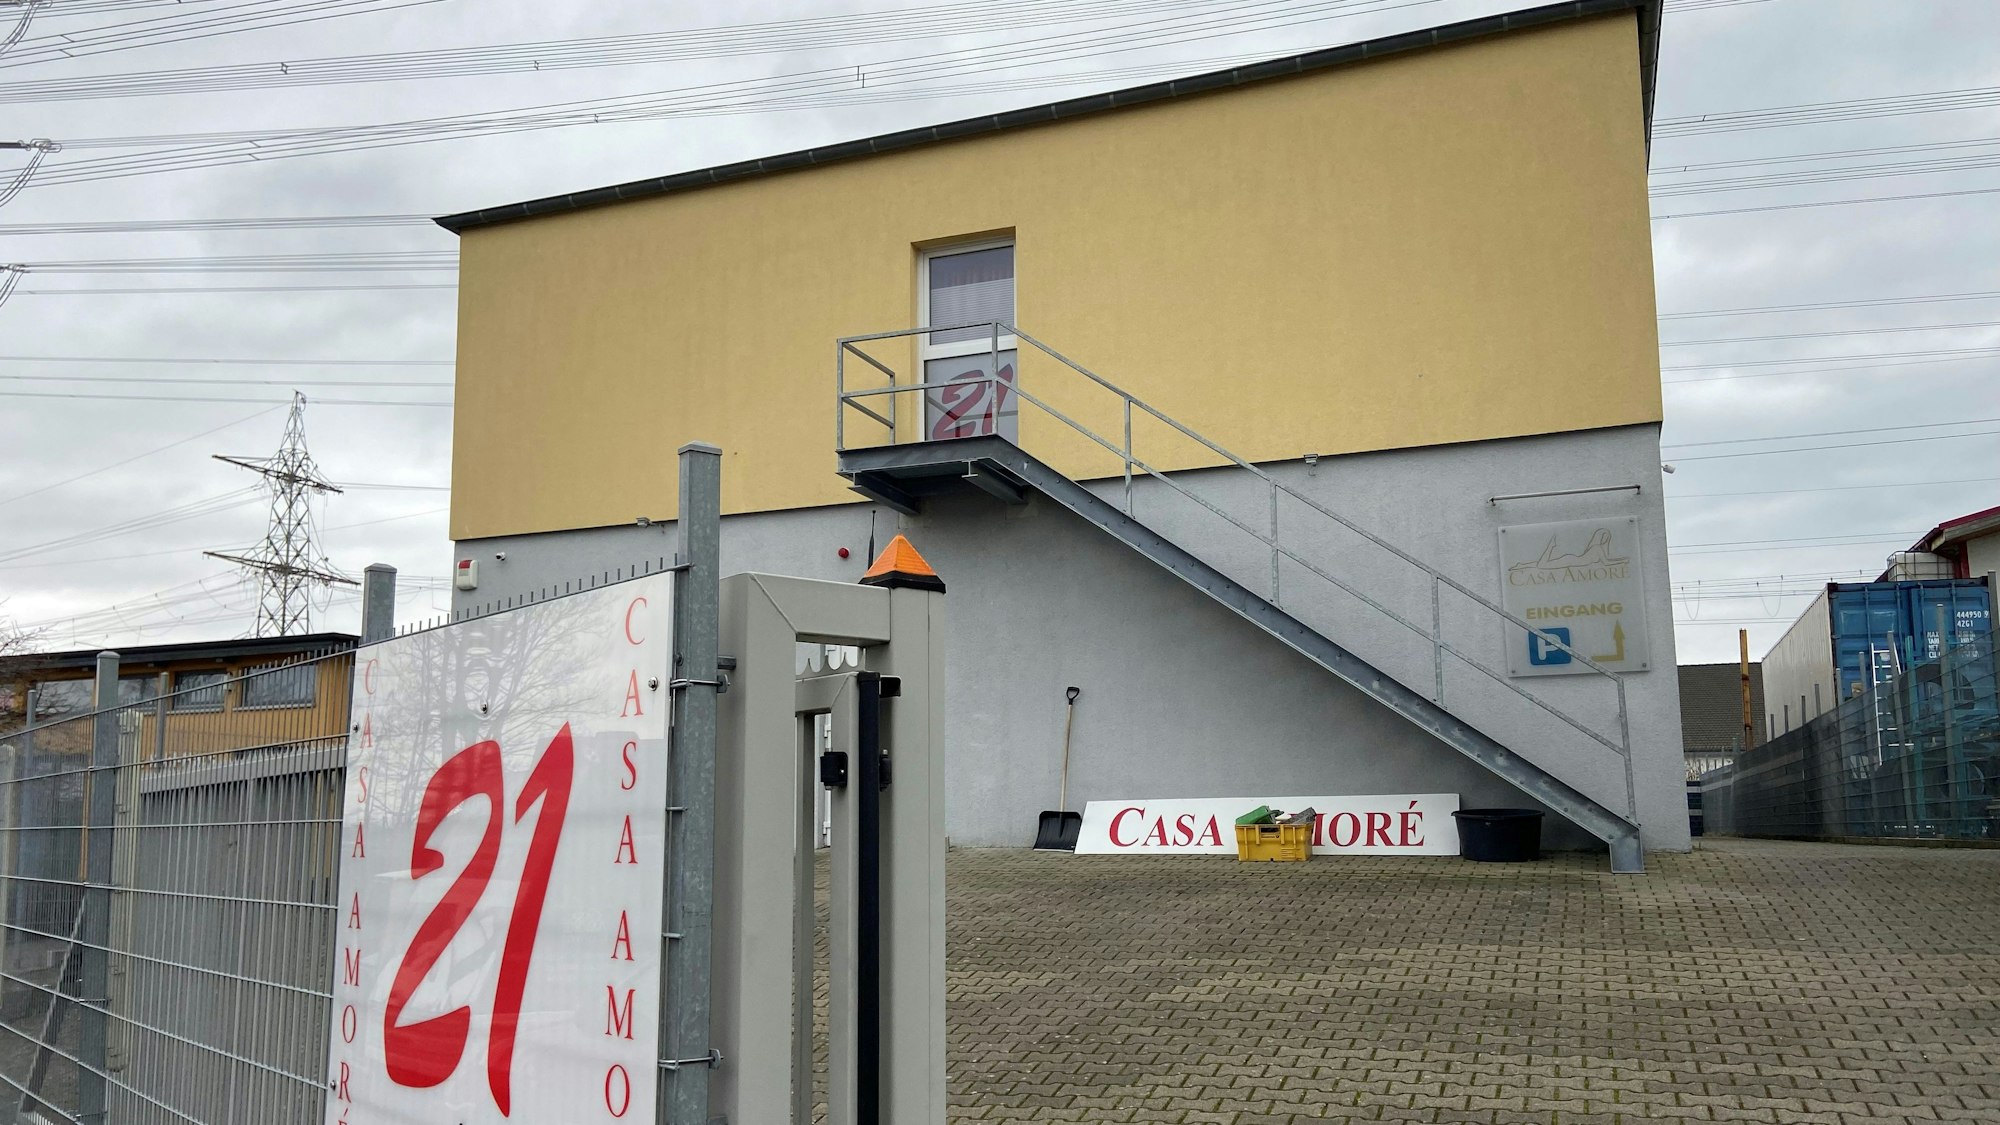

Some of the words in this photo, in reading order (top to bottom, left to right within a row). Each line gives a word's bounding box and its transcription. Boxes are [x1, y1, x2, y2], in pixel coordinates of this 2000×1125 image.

[932, 363, 1014, 440] 21
[1509, 567, 1557, 586] CASA
[1526, 602, 1624, 620] EINGANG
[351, 657, 380, 860] CASA
[613, 596, 648, 865] CASA
[1108, 807, 1225, 848] CASA
[383, 720, 575, 1119] 21
[336, 890, 361, 1125] AMOR
